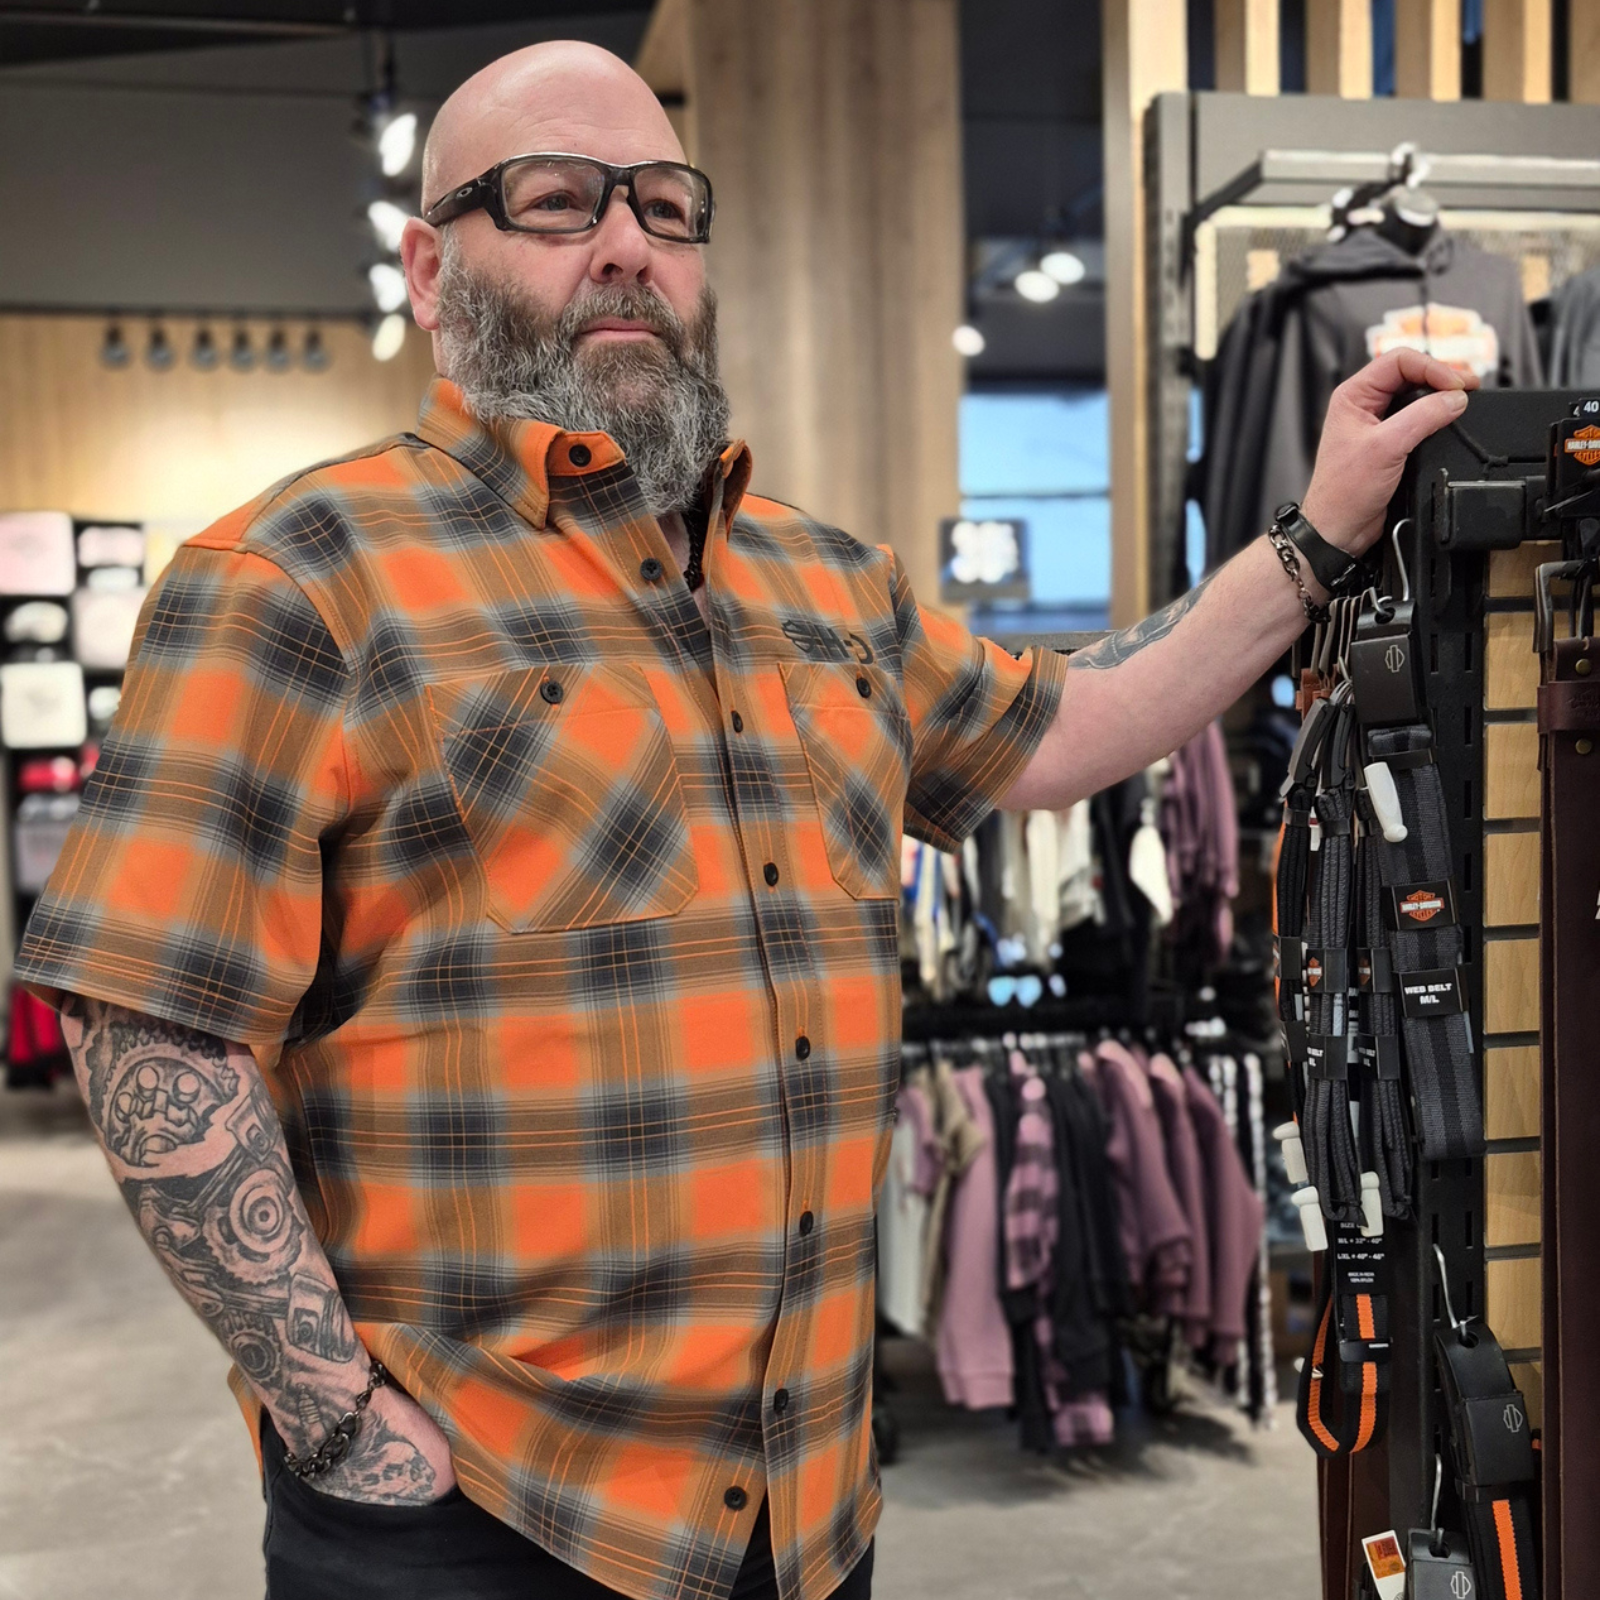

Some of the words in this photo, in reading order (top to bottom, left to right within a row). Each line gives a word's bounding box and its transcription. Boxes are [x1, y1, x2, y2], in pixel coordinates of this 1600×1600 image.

[1583, 400, 1599, 413] 40
[1404, 985, 1426, 995] WEB
[1427, 982, 1453, 992] BELT
[1420, 994, 1440, 1005] M/L
